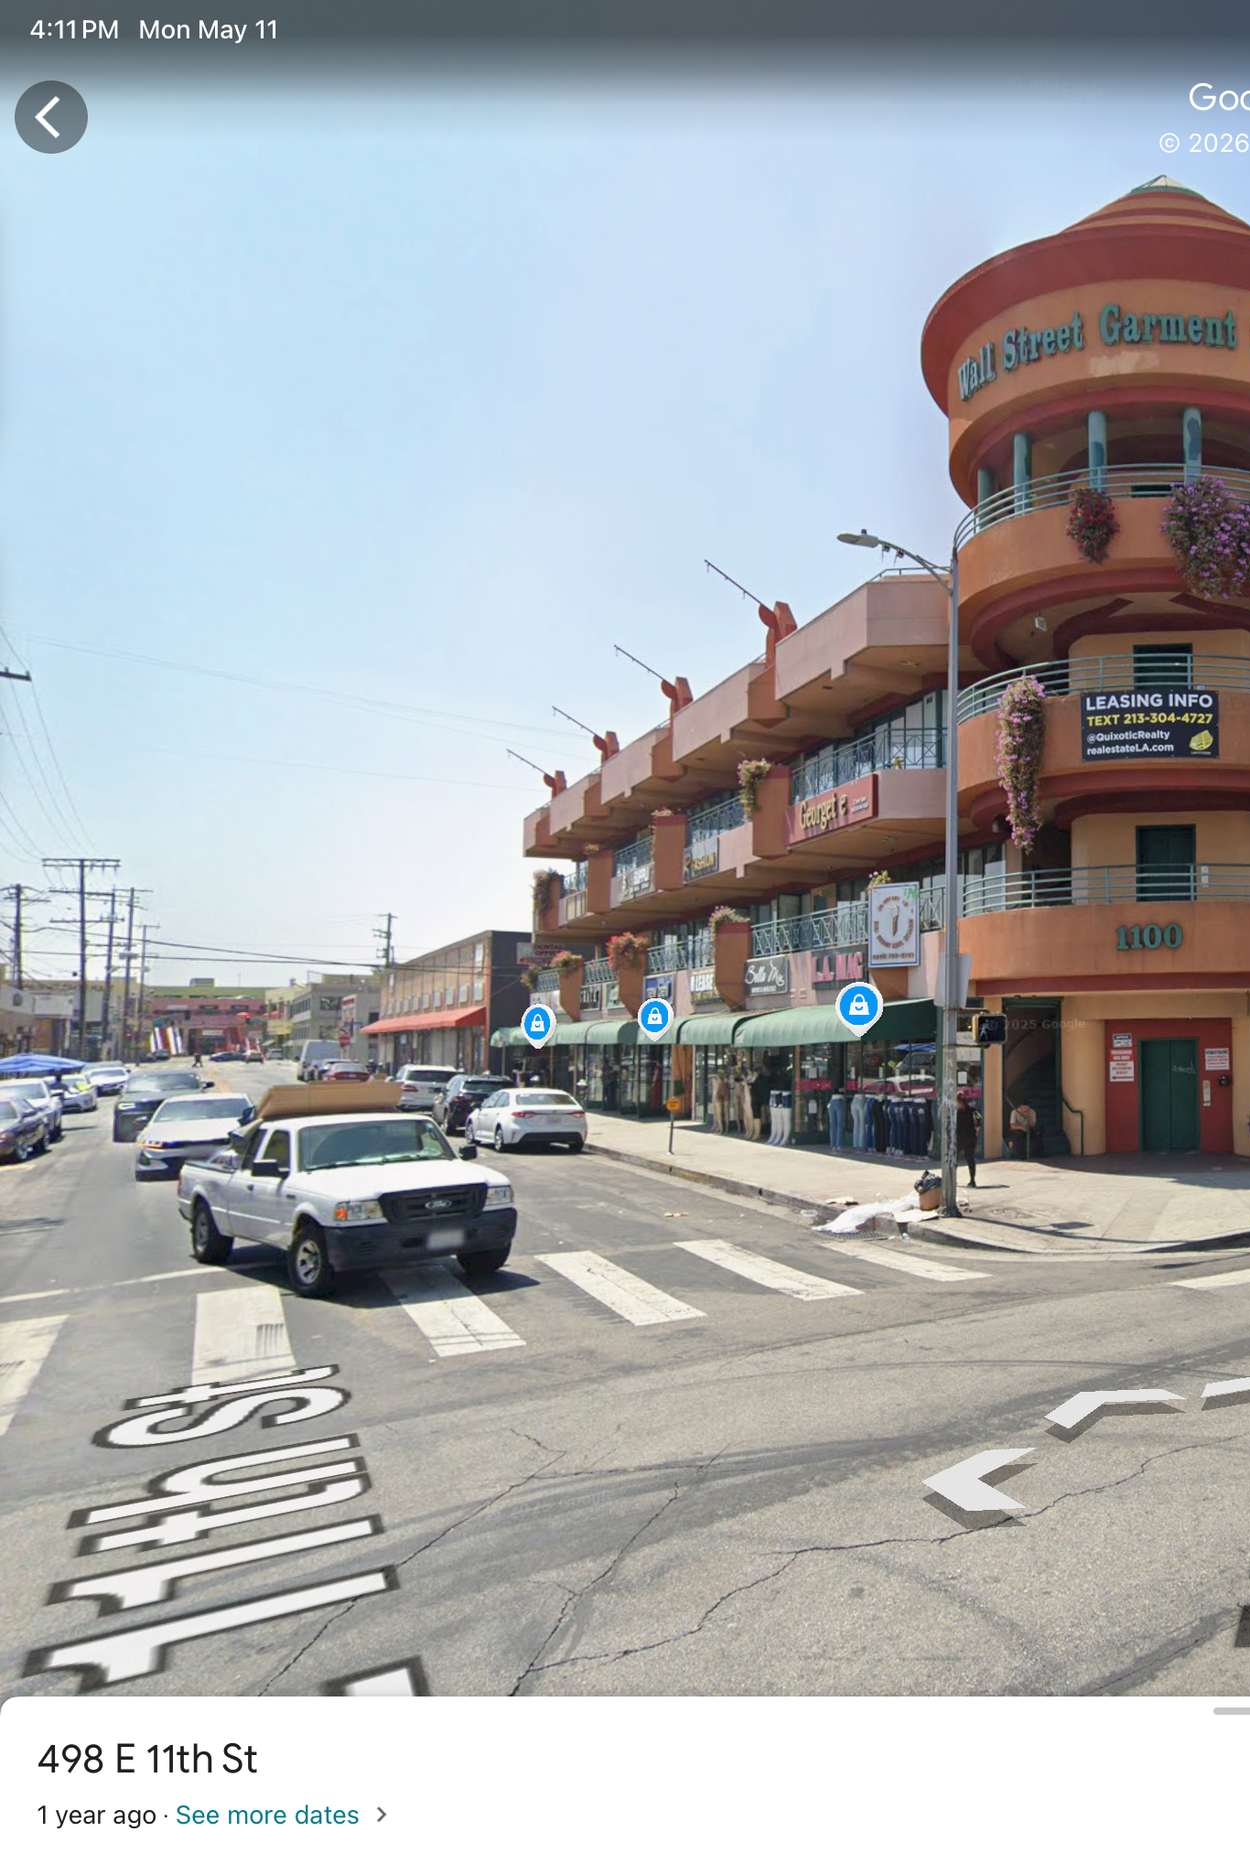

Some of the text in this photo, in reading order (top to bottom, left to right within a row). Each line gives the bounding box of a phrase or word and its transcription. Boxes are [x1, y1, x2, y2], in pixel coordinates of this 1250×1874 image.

[958, 341, 996, 401] Wall
[1002, 312, 1085, 372] Street
[1100, 304, 1238, 349] Garment
[1086, 693, 1213, 710] LEASING INFO
[1087, 713, 1213, 727] TEXT 213-304-4727
[1087, 730, 1170, 744] @QuixoticRealty
[1087, 743, 1174, 755] realestateLA.com
[1115, 923, 1184, 951] 1100
